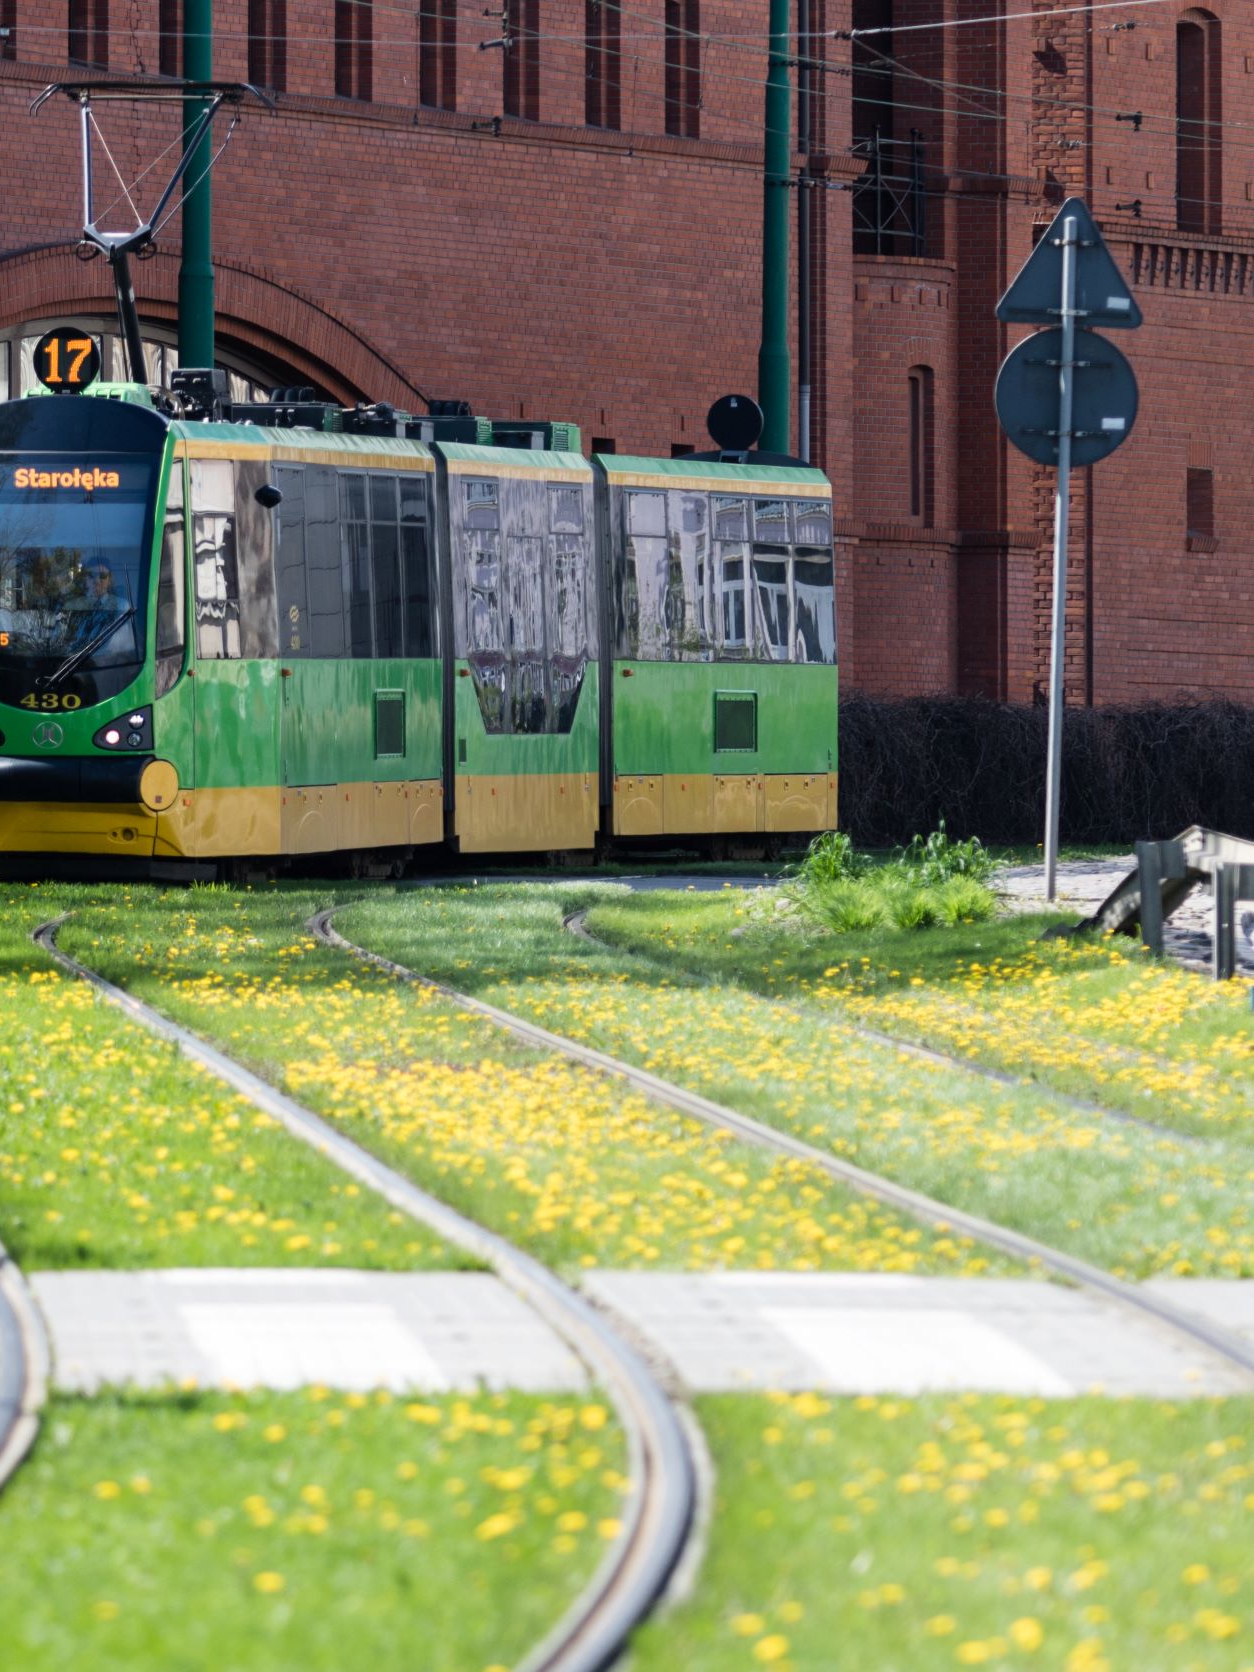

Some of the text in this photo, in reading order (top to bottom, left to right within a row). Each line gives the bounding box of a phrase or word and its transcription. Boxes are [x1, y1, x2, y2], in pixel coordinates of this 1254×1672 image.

[44, 338, 92, 383] 17
[14, 467, 119, 490] Starołęka
[0, 632, 10, 648] 5
[20, 692, 82, 709] 430
